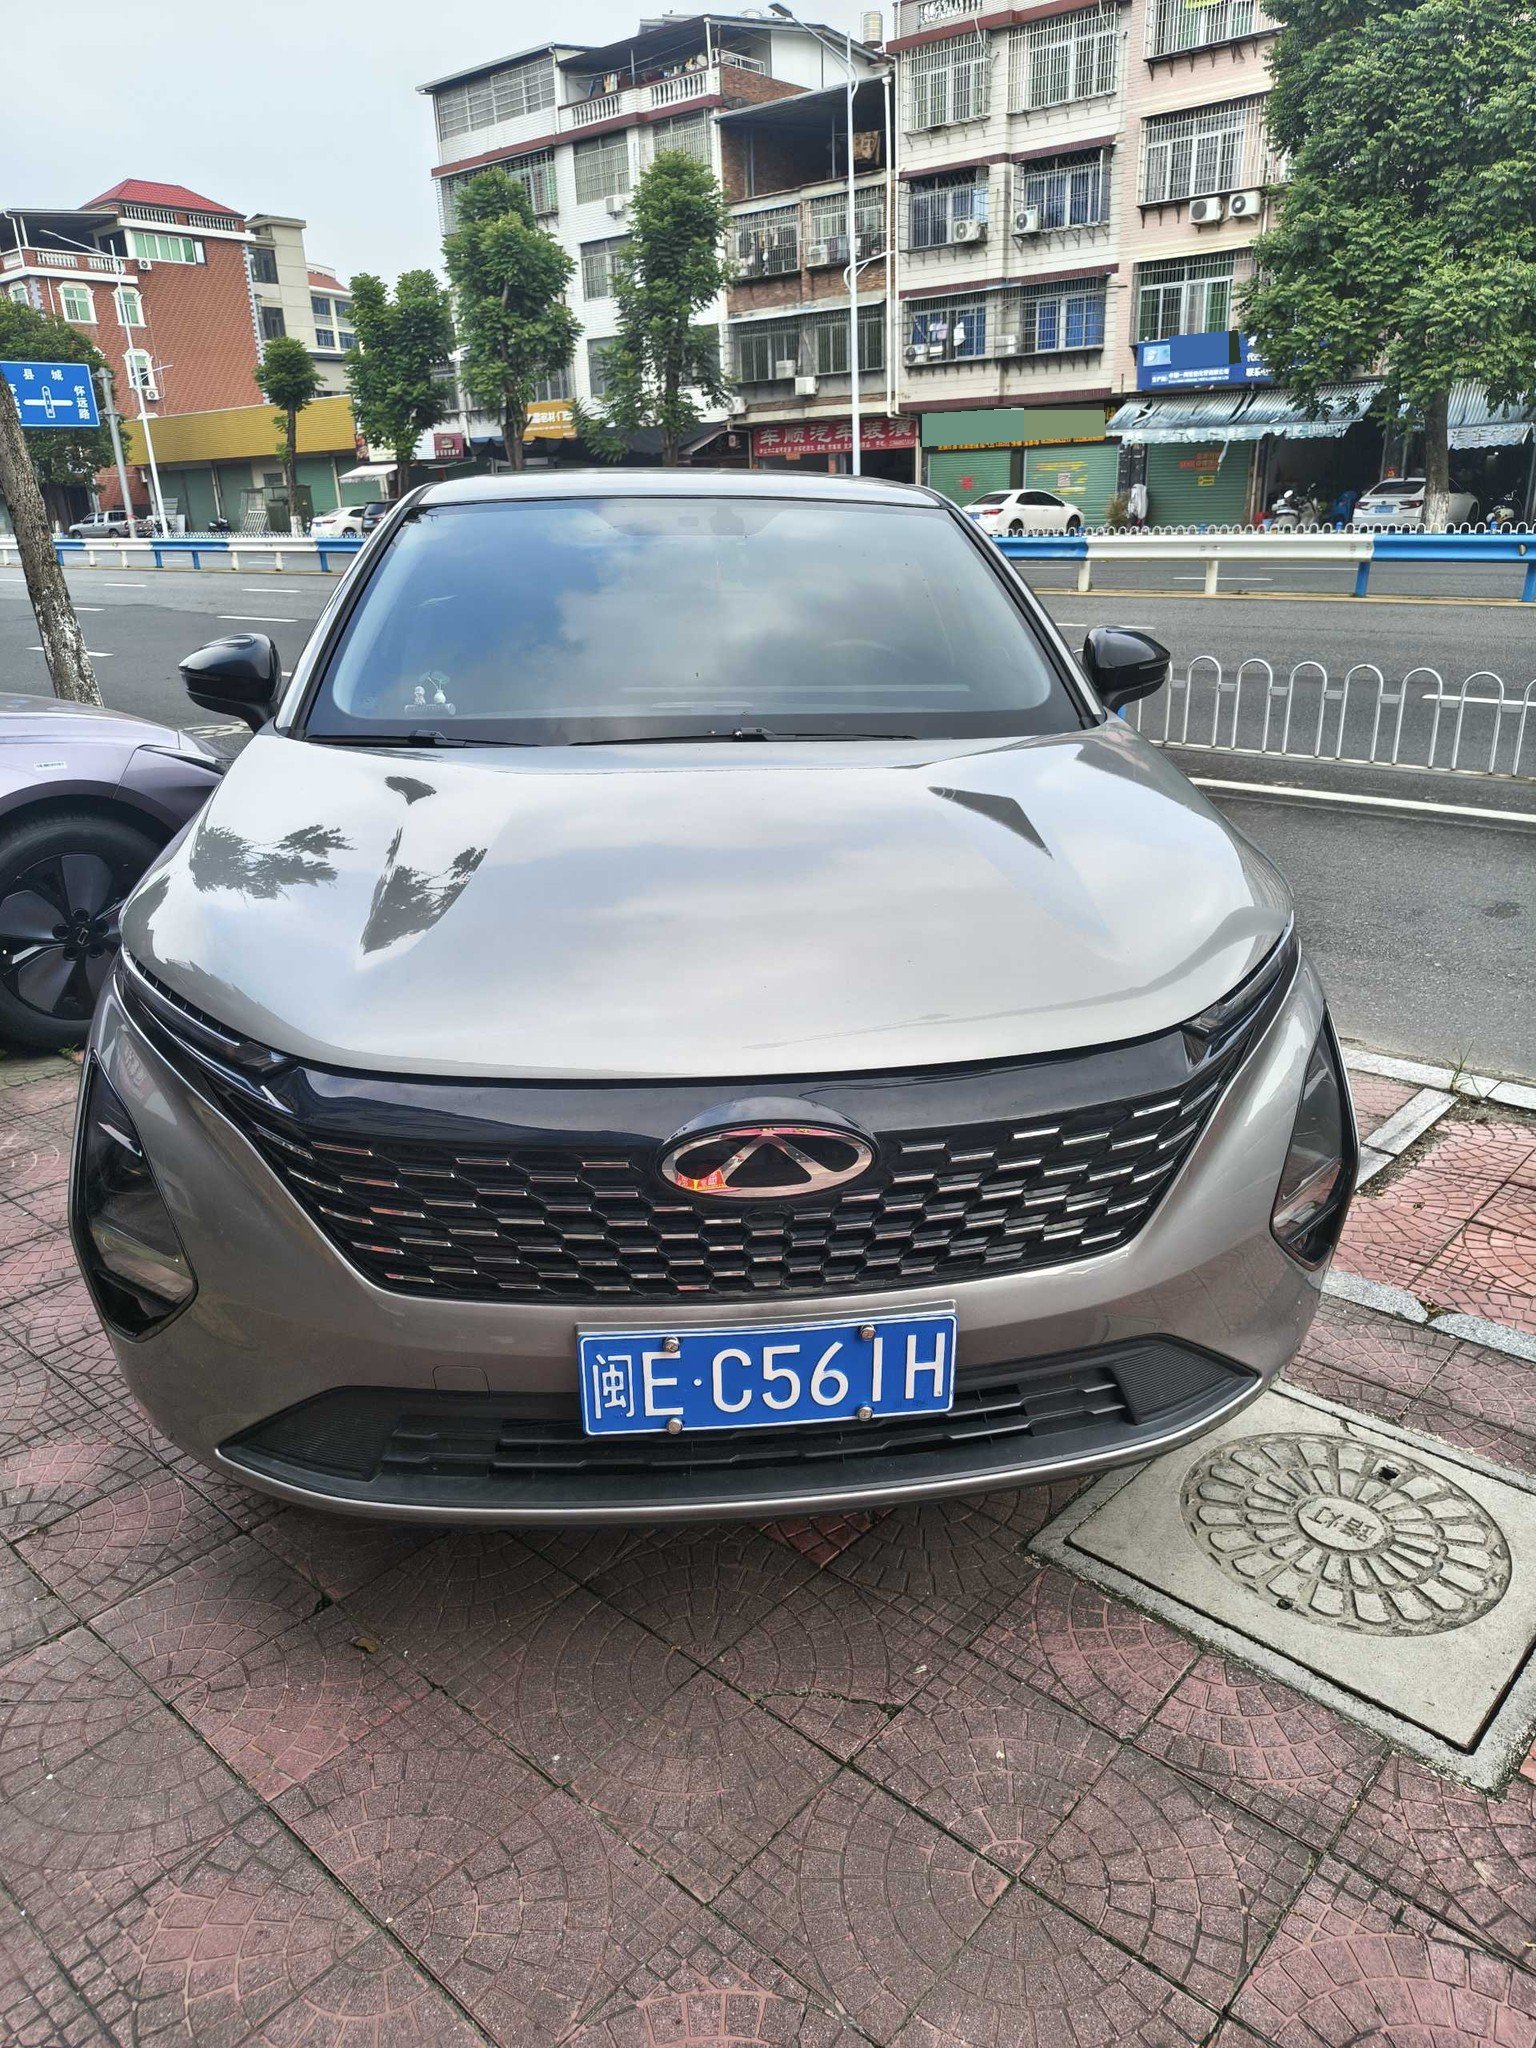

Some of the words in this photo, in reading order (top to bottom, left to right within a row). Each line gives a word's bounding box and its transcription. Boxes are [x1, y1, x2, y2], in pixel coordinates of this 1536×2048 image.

[22, 368, 64, 381] 县城
[73, 385, 91, 420] 怀远路
[1307, 1505, 1377, 1542] 路灯
